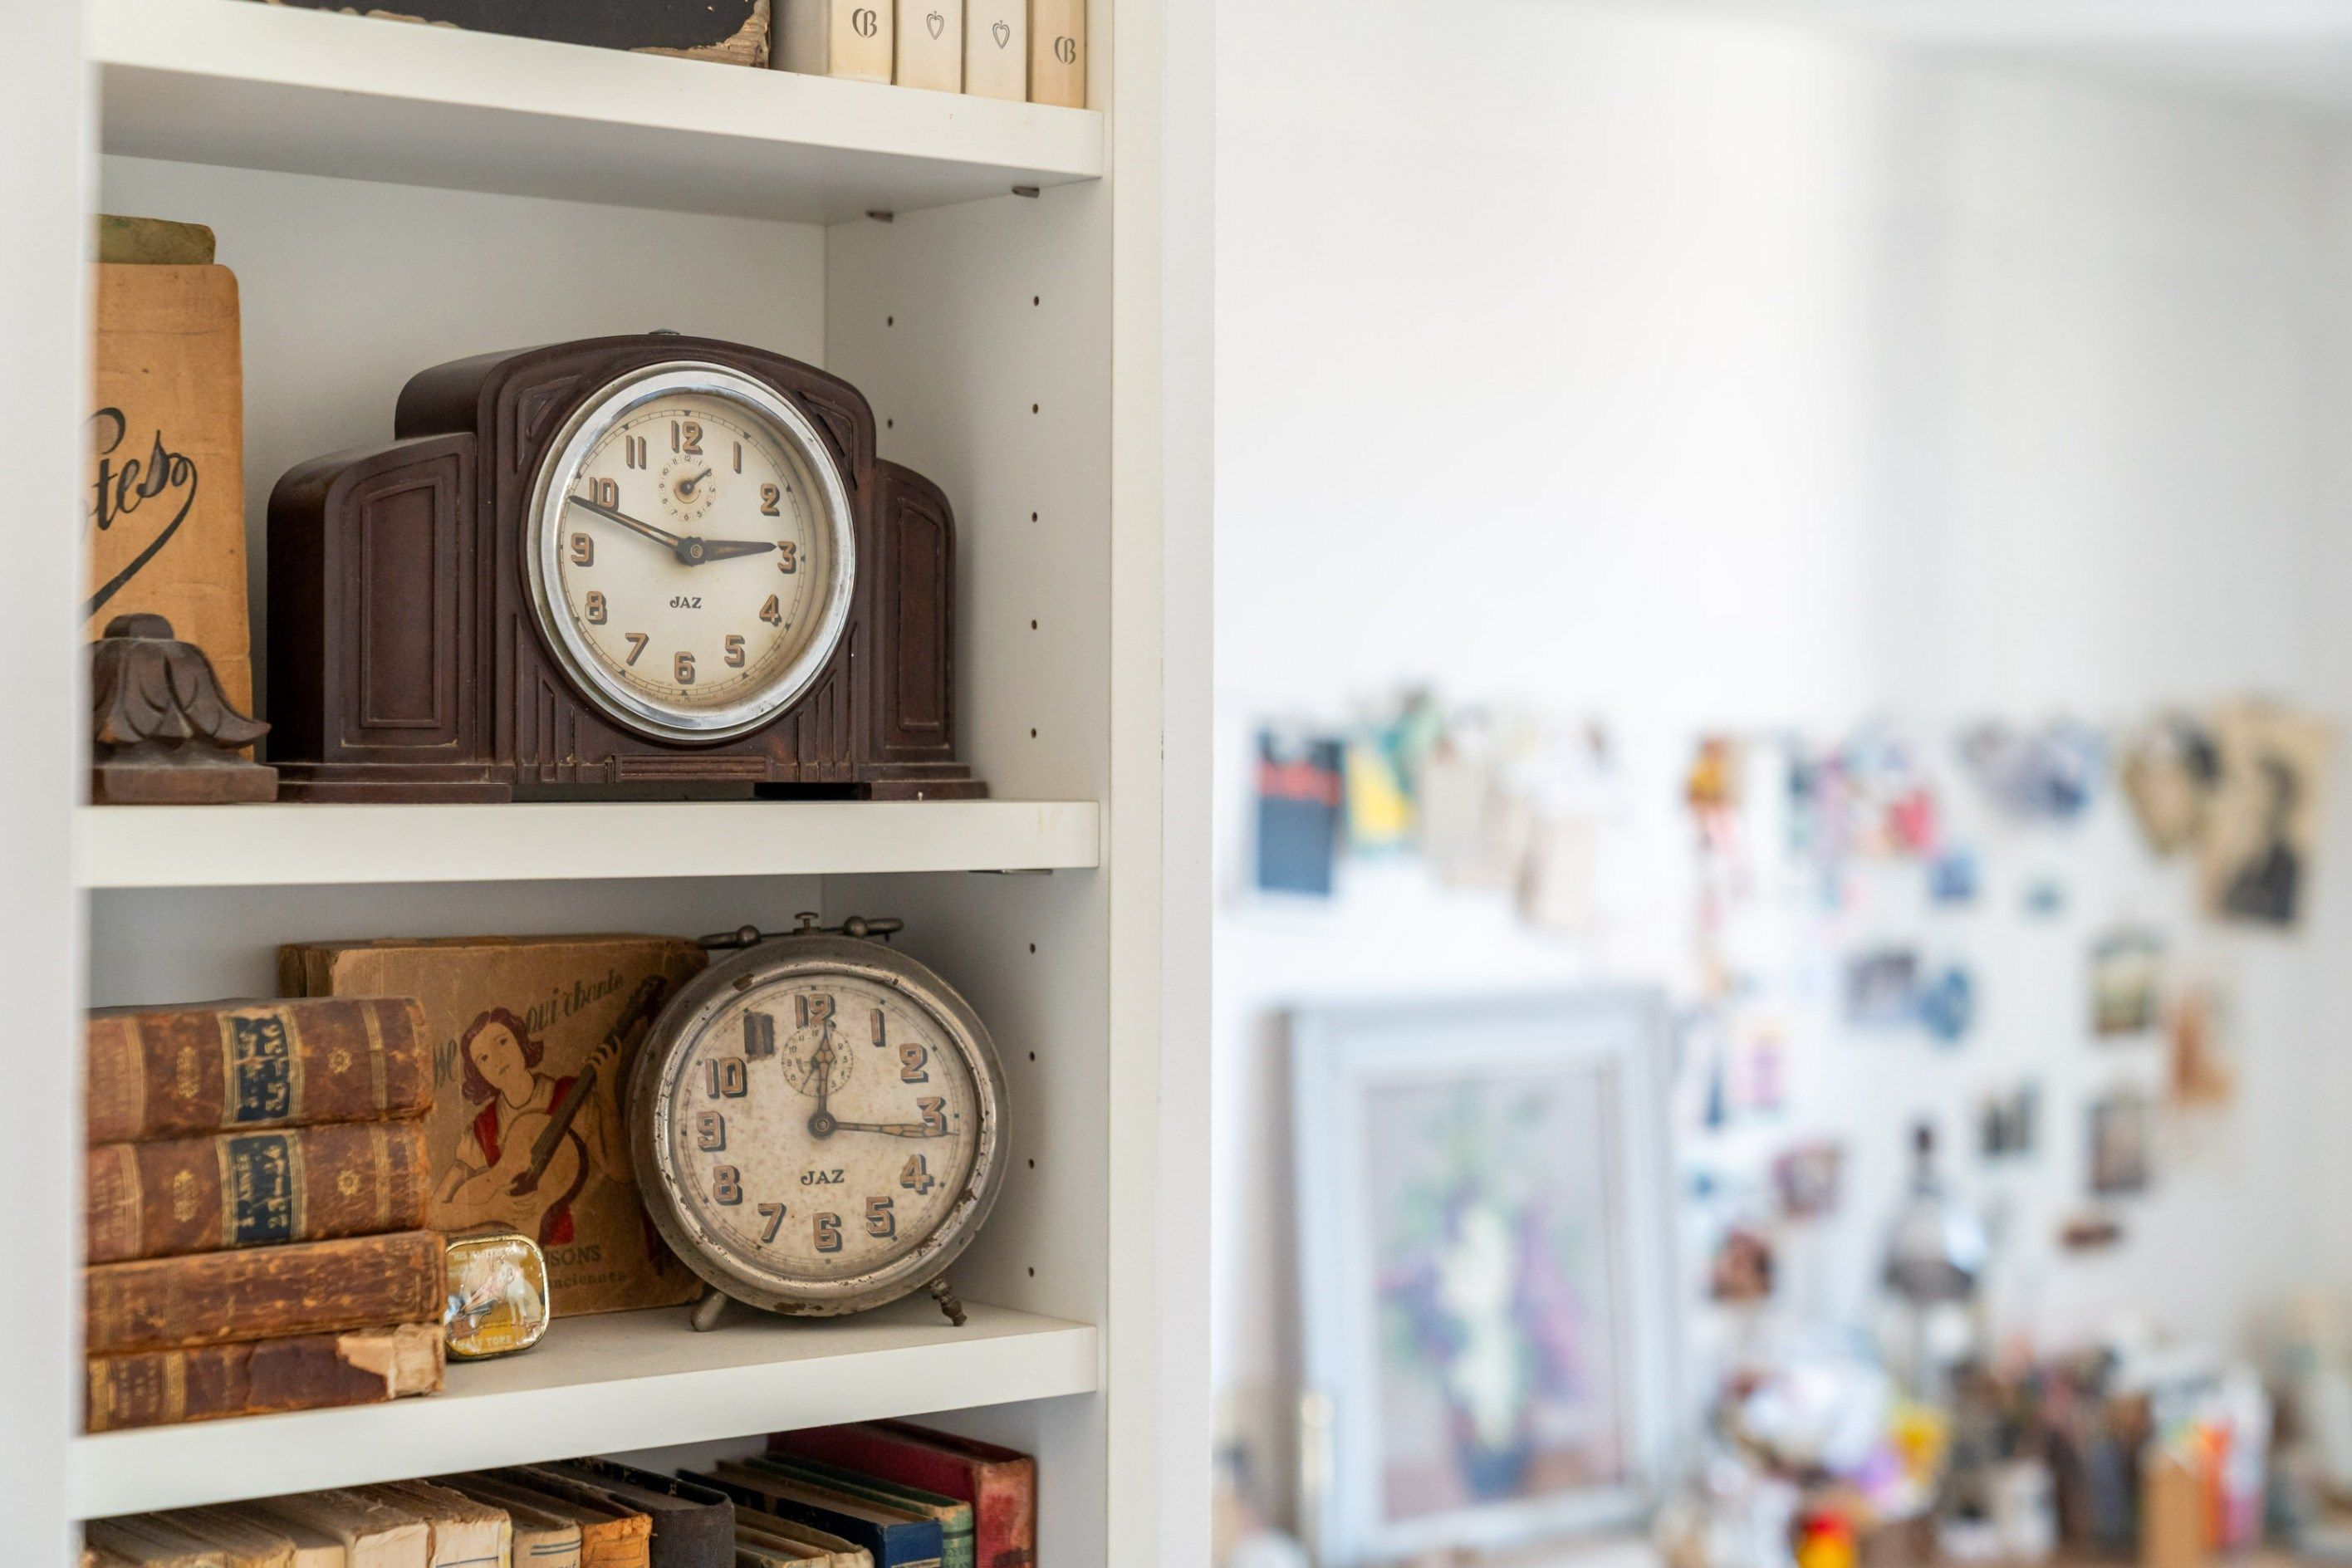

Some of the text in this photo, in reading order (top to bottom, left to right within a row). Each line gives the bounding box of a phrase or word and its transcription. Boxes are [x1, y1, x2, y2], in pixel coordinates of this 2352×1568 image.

[625, 435, 647, 469] 11
[670, 420, 703, 455] 12
[733, 441, 742, 473] 1
[589, 478, 619, 512] 10
[760, 483, 780, 516] 2
[571, 532, 594, 566] 9
[777, 541, 796, 573] 3
[585, 591, 607, 625] 8
[669, 596, 702, 610] JAZ
[759, 594, 782, 625] 4
[625, 633, 649, 666] 7
[724, 635, 745, 667] 5
[674, 651, 696, 684] 6
[794, 993, 836, 1029] 12
[870, 1007, 885, 1047] 1
[704, 1056, 747, 1099] 10
[899, 1043, 929, 1083] 2
[697, 1110, 726, 1152] 9
[916, 1096, 947, 1136] 3
[713, 1164, 742, 1206] 8
[800, 1169, 845, 1186] JAZ
[899, 1154, 934, 1194] 4
[757, 1203, 786, 1243] 7
[811, 1212, 841, 1253] 6
[865, 1195, 895, 1237] 5
